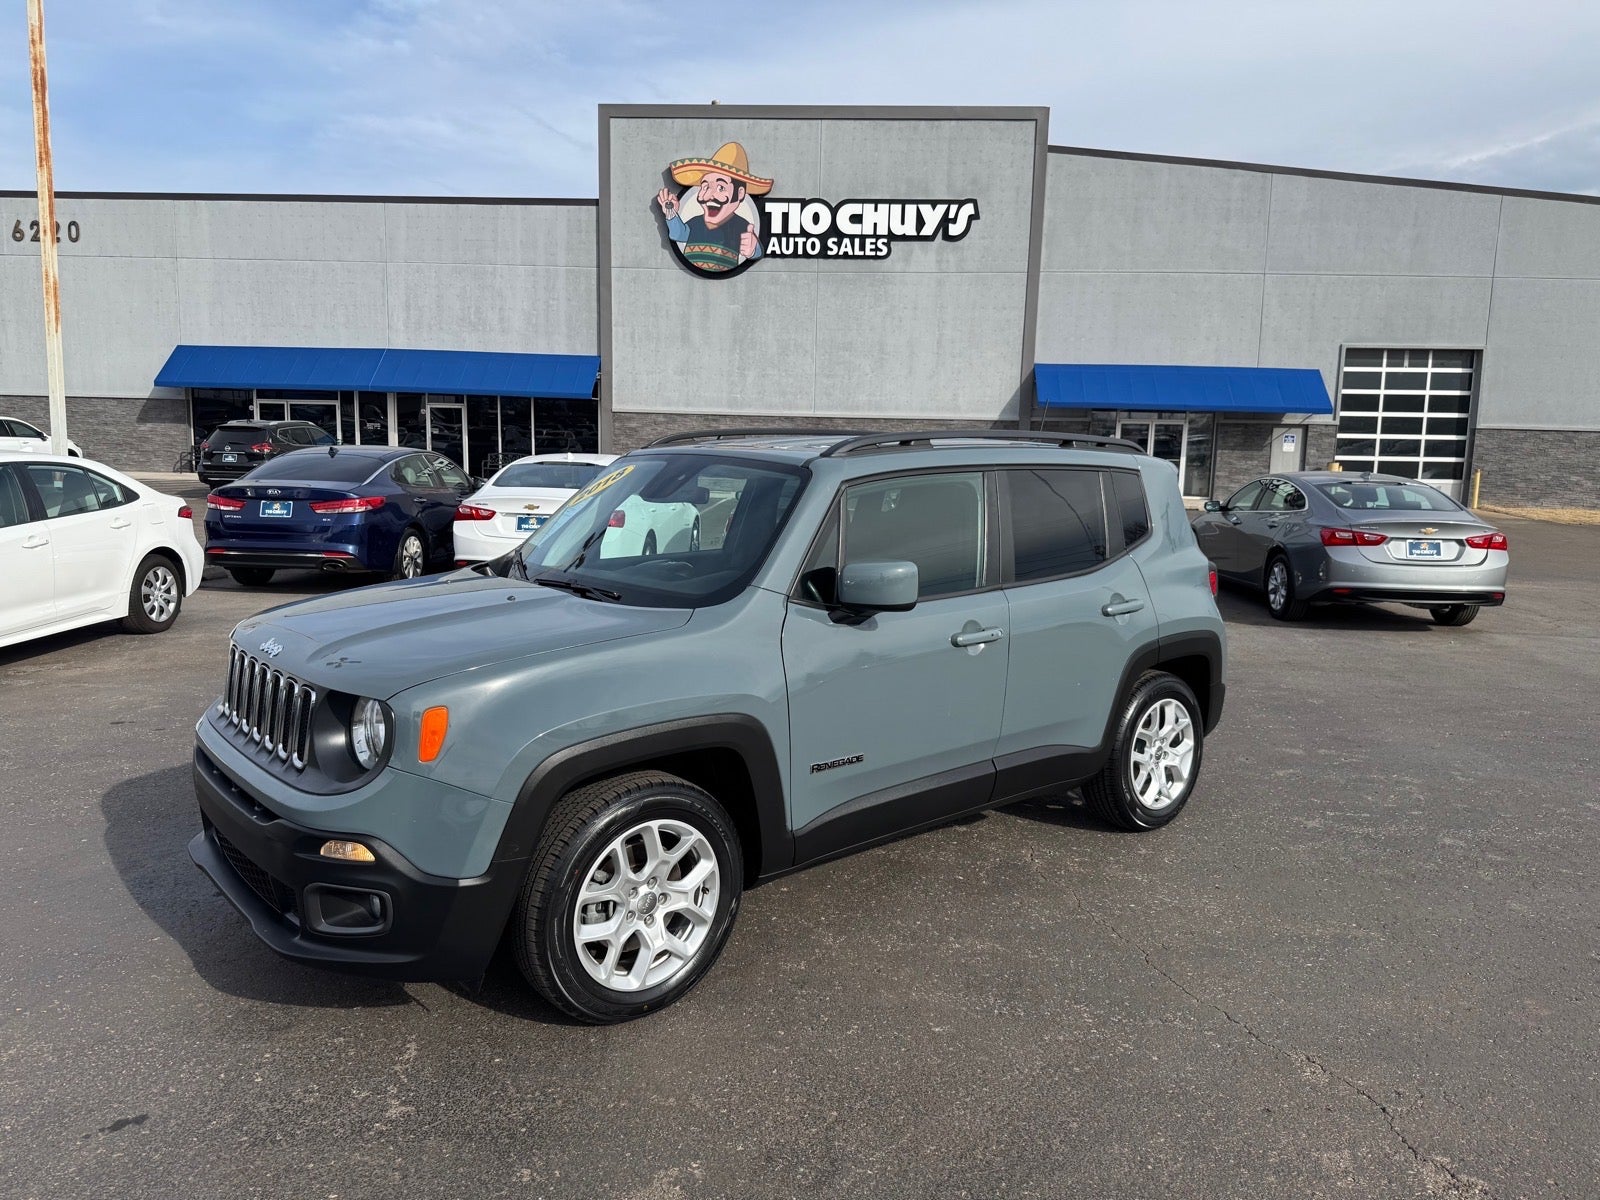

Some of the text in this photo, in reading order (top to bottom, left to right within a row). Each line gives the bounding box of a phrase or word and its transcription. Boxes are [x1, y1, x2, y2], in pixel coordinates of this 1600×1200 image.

[765, 202, 975, 236] TIO CHUY'S
[766, 237, 888, 257] AUTO SALES
[260, 638, 284, 658] Jeep
